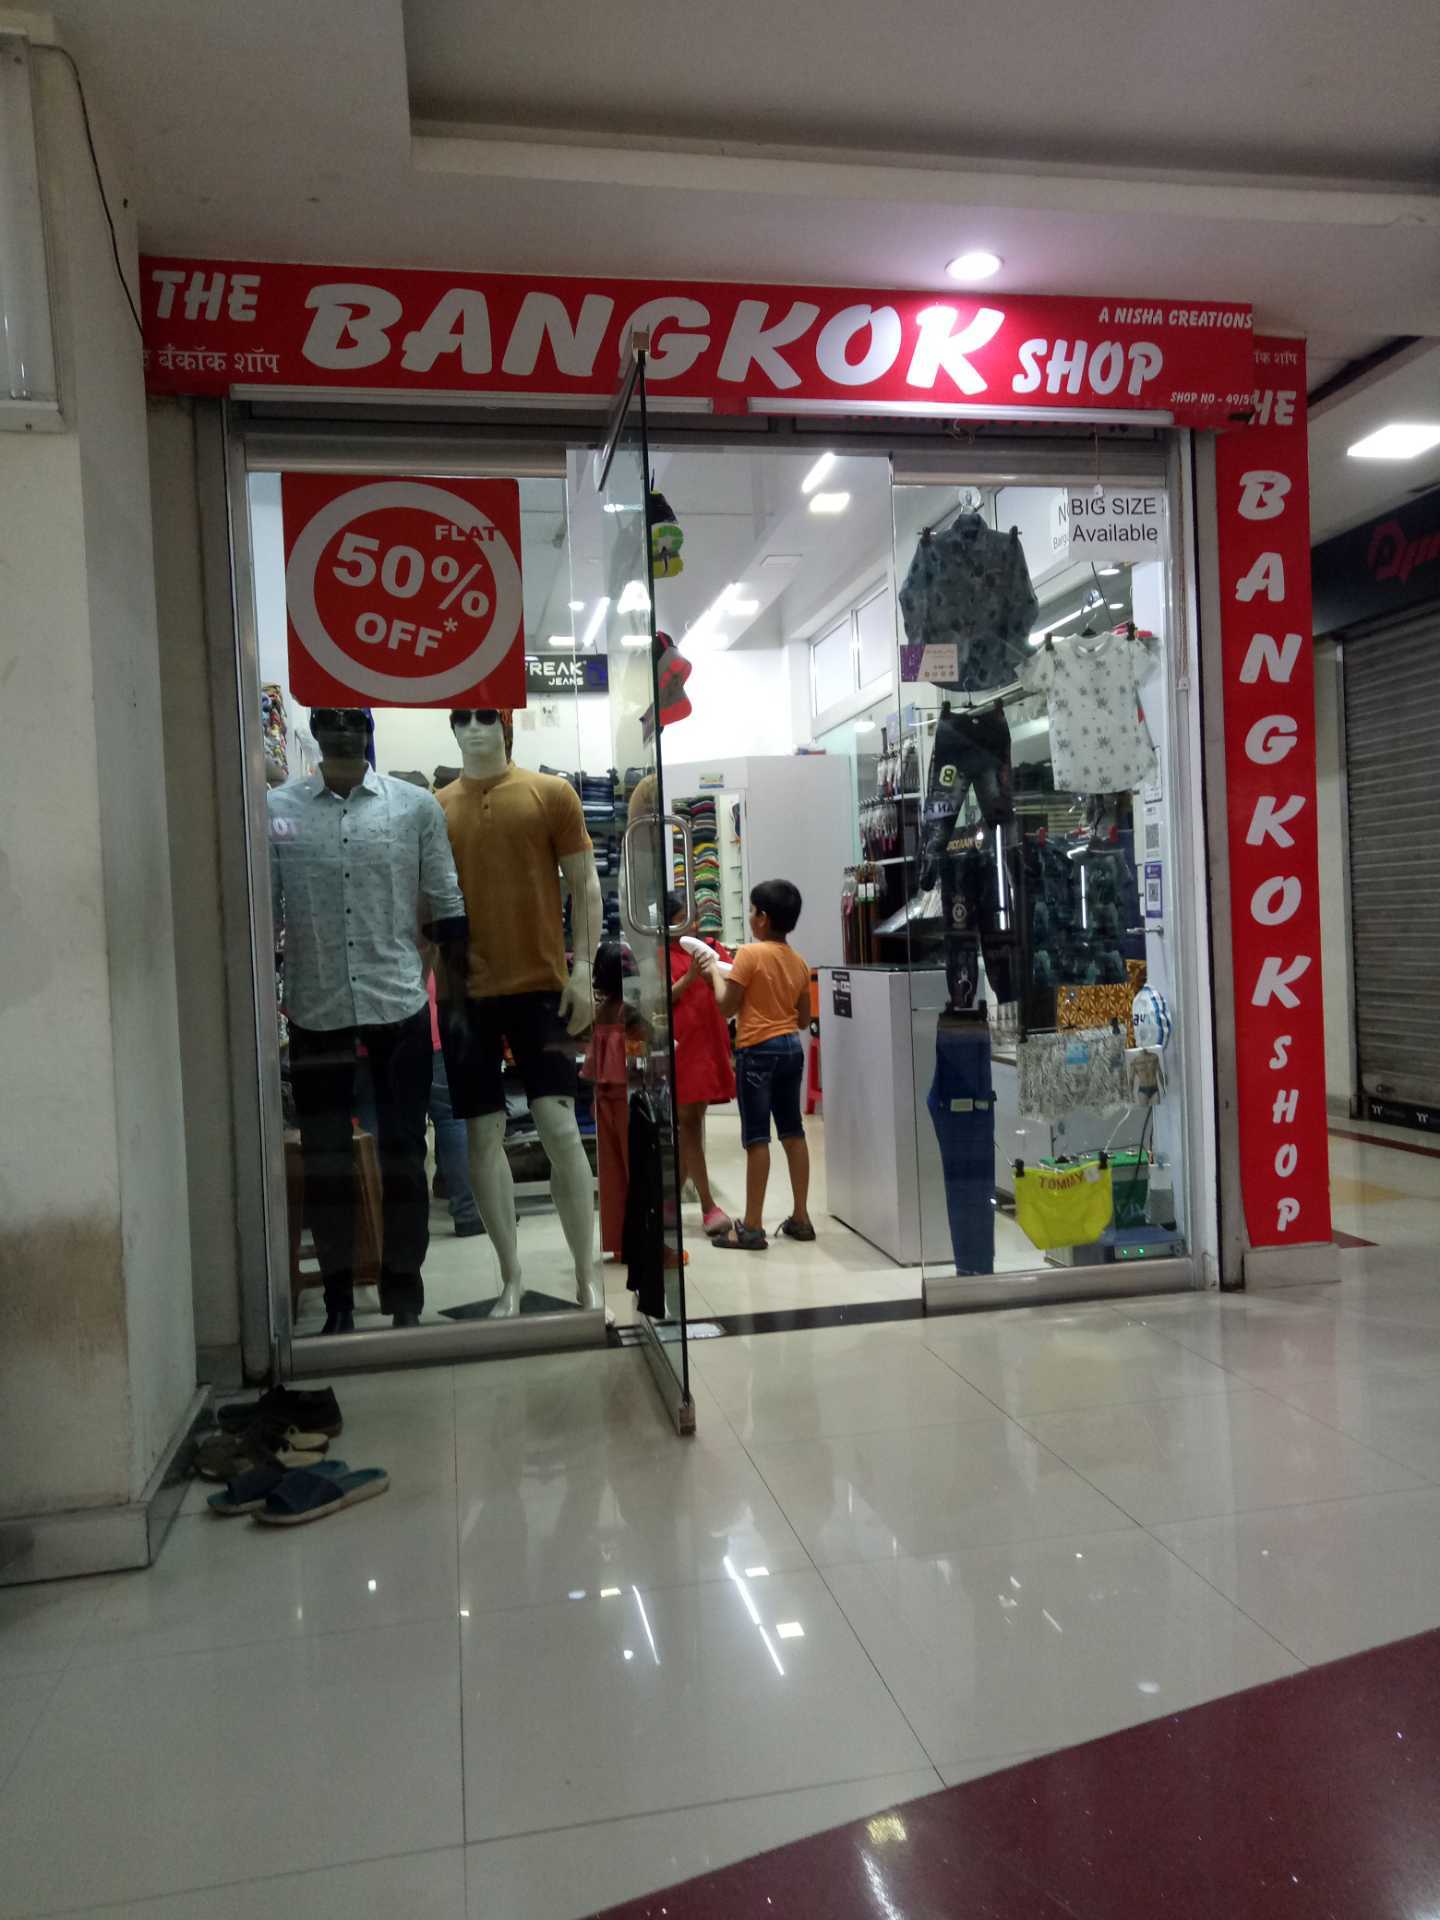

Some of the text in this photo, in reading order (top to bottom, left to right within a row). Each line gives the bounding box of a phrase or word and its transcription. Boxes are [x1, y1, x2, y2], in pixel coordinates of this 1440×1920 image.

[1099, 307, 1254, 329] A NISHA CREATIONS
[151, 270, 1164, 396] THE BANGKOK SHOP
[233, 347, 280, 373] शॉप
[1170, 392, 1198, 404] SHOP
[1200, 393, 1215, 404] NO
[1248, 389, 1297, 425] HE
[1071, 497, 1157, 515] BIG SIZE
[434, 524, 497, 542] FLAT
[1072, 523, 1158, 542] Available
[332, 532, 489, 618] 50%
[525, 661, 583, 676] REAK
[548, 677, 584, 685] JEANS
[1235, 470, 1311, 1232] BANGKOK SHOP
[1039, 1170, 1083, 1190] TOMMY
